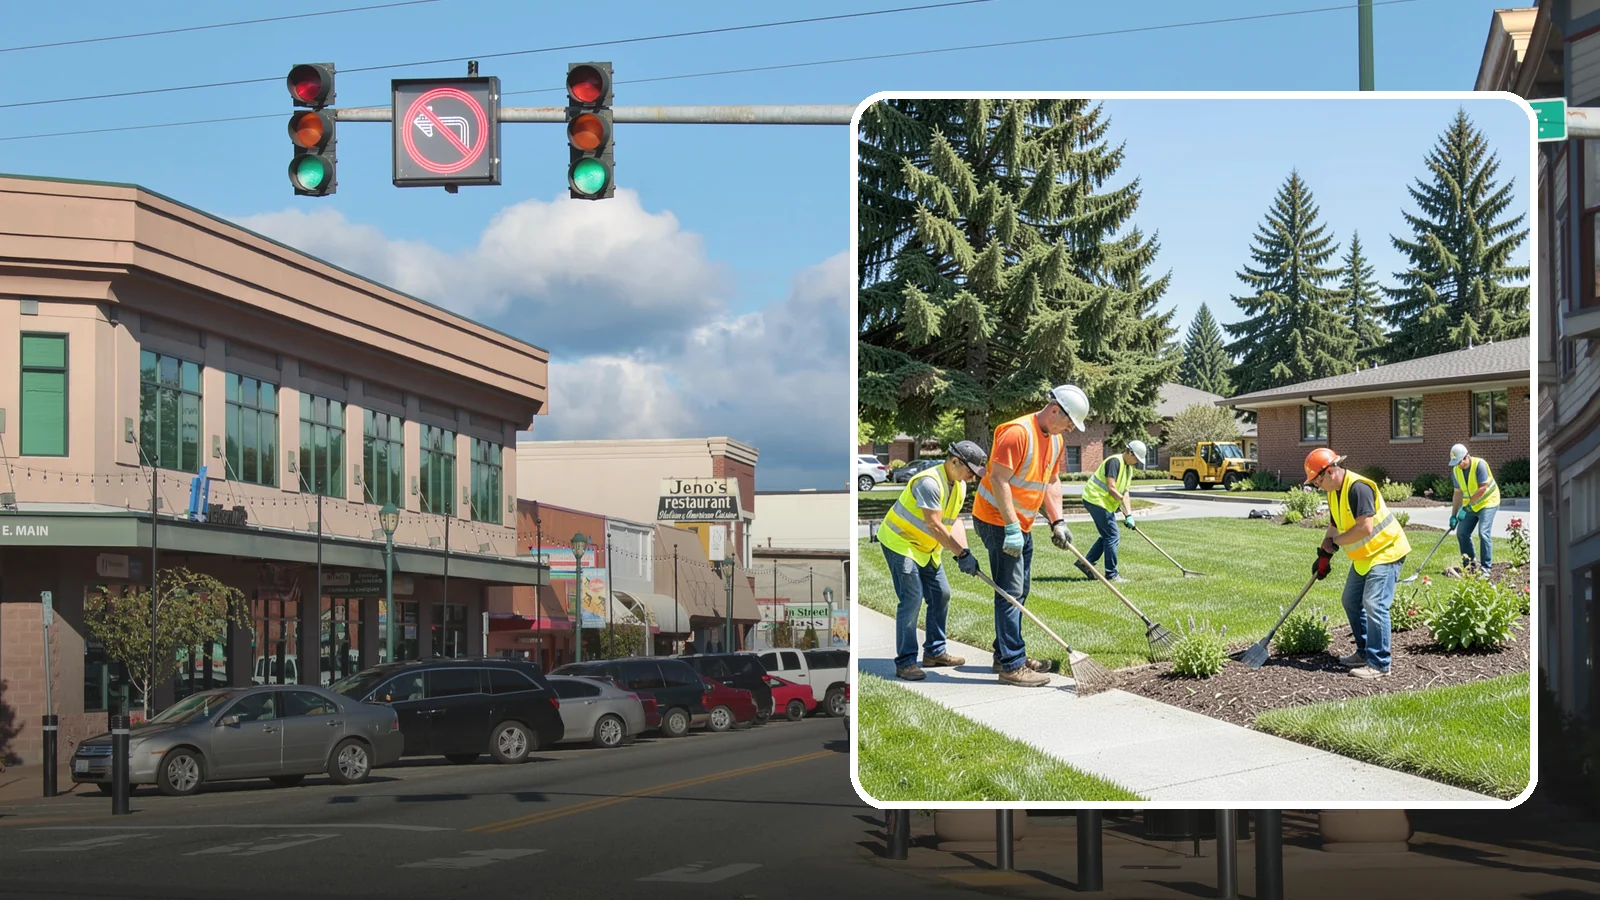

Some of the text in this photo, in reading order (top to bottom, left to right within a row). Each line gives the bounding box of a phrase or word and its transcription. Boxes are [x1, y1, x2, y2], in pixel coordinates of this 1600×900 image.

[669, 480, 727, 494] Jeno's
[665, 496, 730, 509] restaurant
[659, 510, 681, 519] Italian
[686, 510, 714, 519] American
[715, 510, 737, 519] Cuisine
[2, 525, 49, 536] E. MAIN
[797, 607, 828, 617] Street
